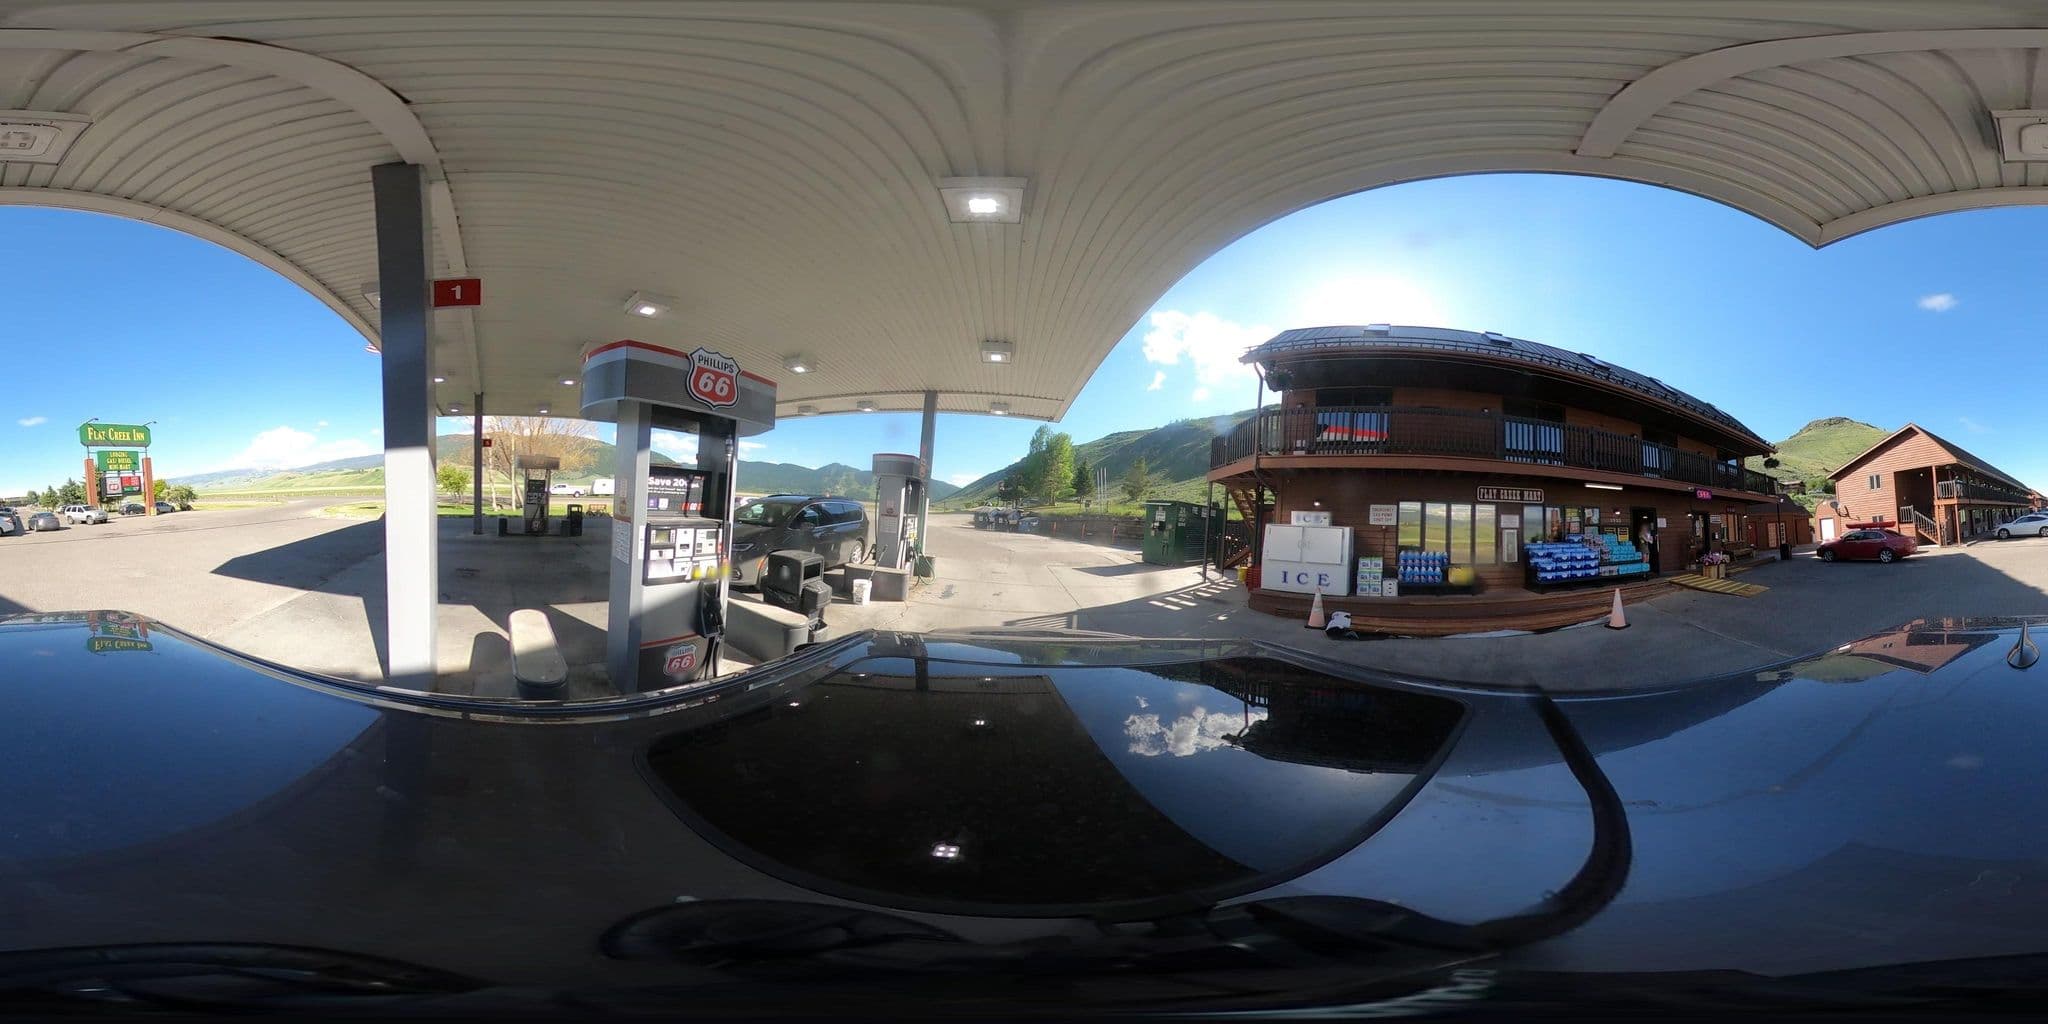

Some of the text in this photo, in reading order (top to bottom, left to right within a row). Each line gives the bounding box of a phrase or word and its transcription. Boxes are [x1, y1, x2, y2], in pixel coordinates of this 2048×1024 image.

[450, 285, 462, 300] 1
[698, 354, 734, 374] PHILLIPS
[699, 373, 731, 397] 66
[87, 427, 145, 441] FLAT CREEK INN
[648, 477, 671, 487] Save
[1479, 488, 1542, 501] FLAT CREEK MART
[1281, 570, 1331, 587] ICE
[671, 656, 691, 668] 66
